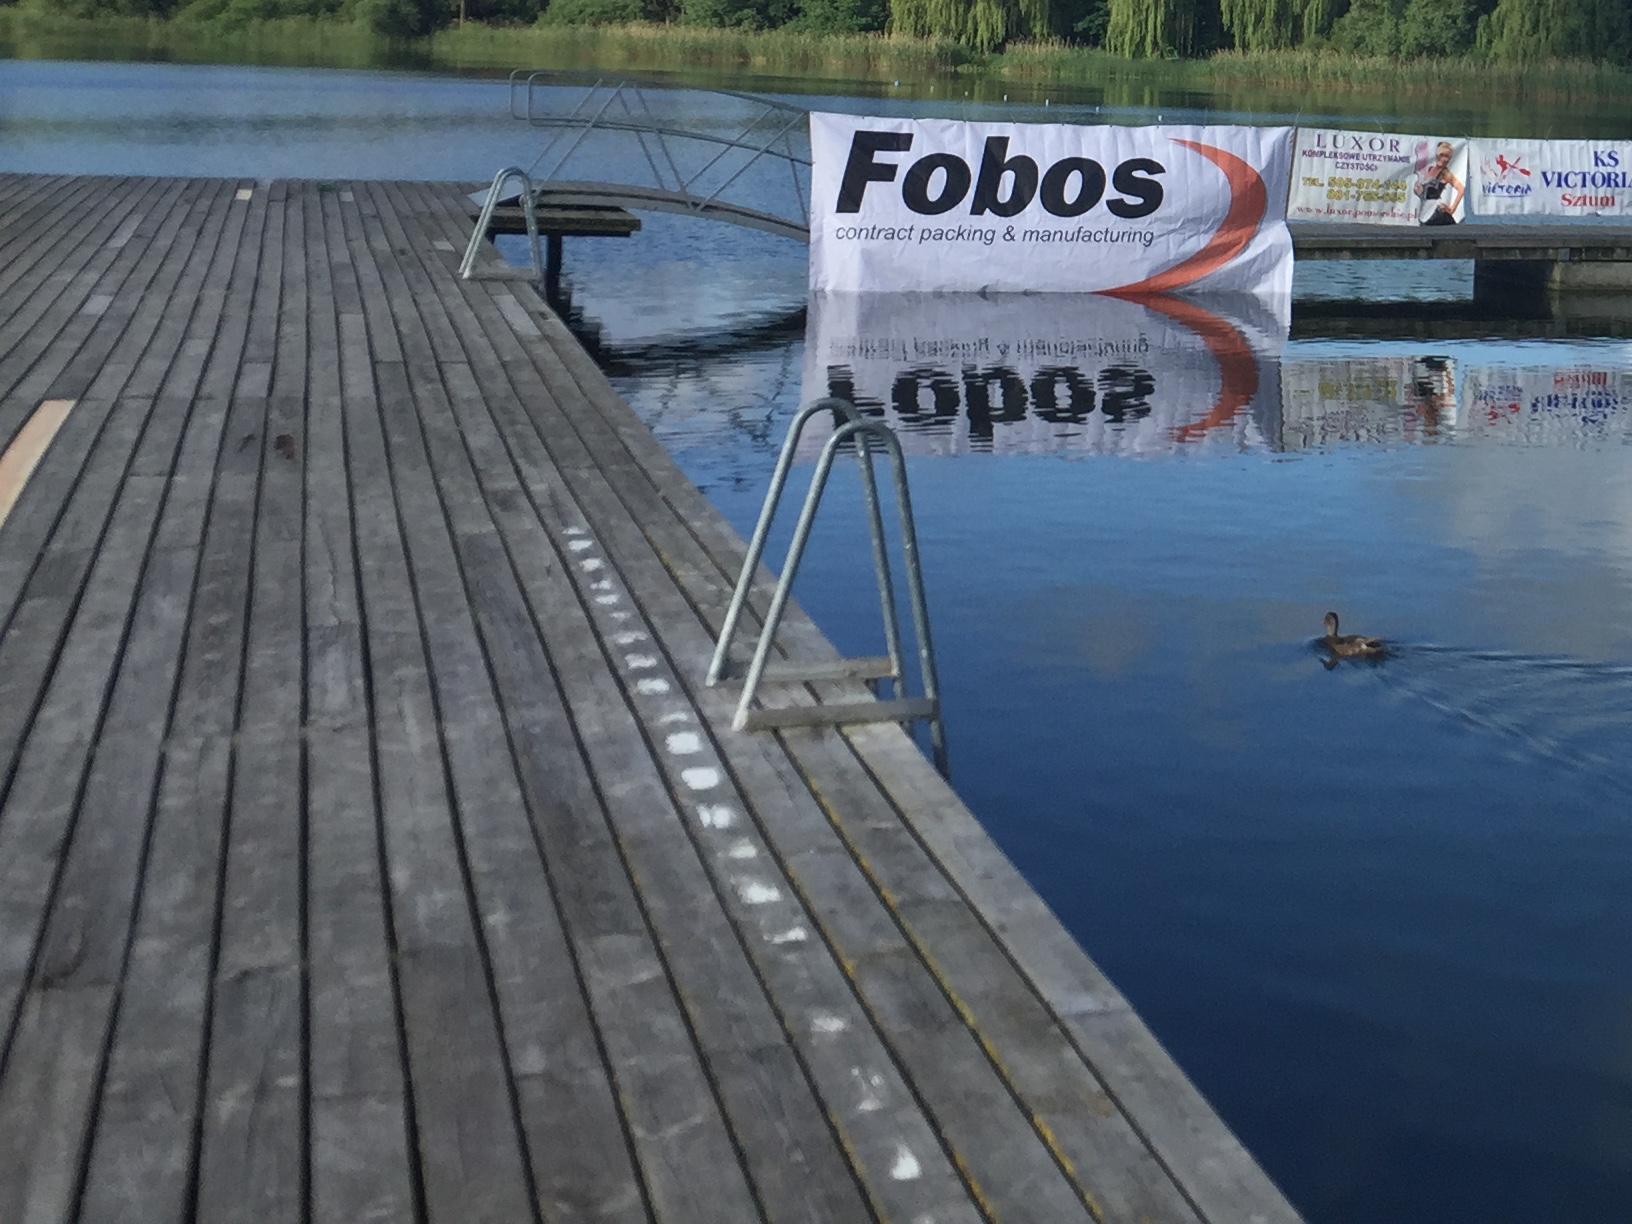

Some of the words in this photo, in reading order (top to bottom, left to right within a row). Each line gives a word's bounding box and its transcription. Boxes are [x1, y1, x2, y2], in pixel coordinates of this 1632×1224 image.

[1316, 133, 1401, 153] LUXOR
[1301, 149, 1361, 161] KOMPLEKSOWE
[1362, 153, 1411, 164] UTRZYMANIE
[1593, 150, 1620, 167] KS
[835, 130, 1167, 219] Fobos
[1560, 193, 1616, 207] Sztum
[835, 224, 914, 242] contract
[919, 225, 996, 246] packing
[1002, 226, 1016, 242] &
[1021, 226, 1154, 247] manufacturing
